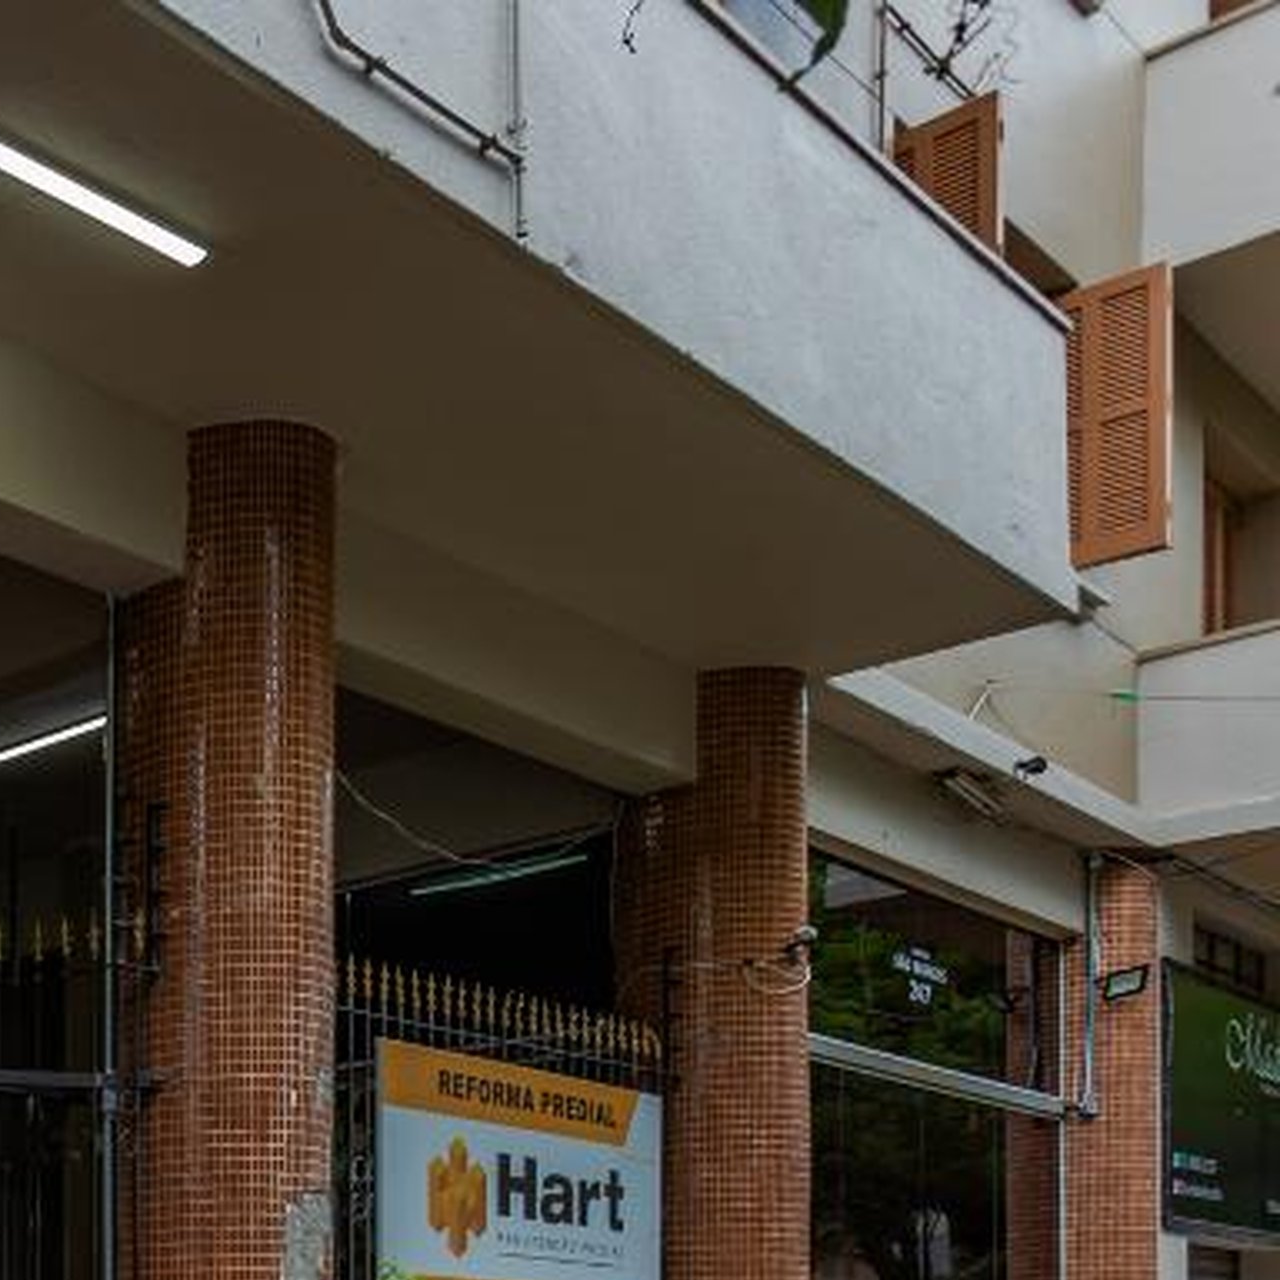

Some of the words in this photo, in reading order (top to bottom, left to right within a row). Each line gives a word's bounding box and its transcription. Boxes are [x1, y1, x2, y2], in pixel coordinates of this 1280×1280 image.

[438, 1069, 535, 1113] REFORMA
[540, 1092, 617, 1128] PREDIAL
[496, 1152, 625, 1232] Hart
